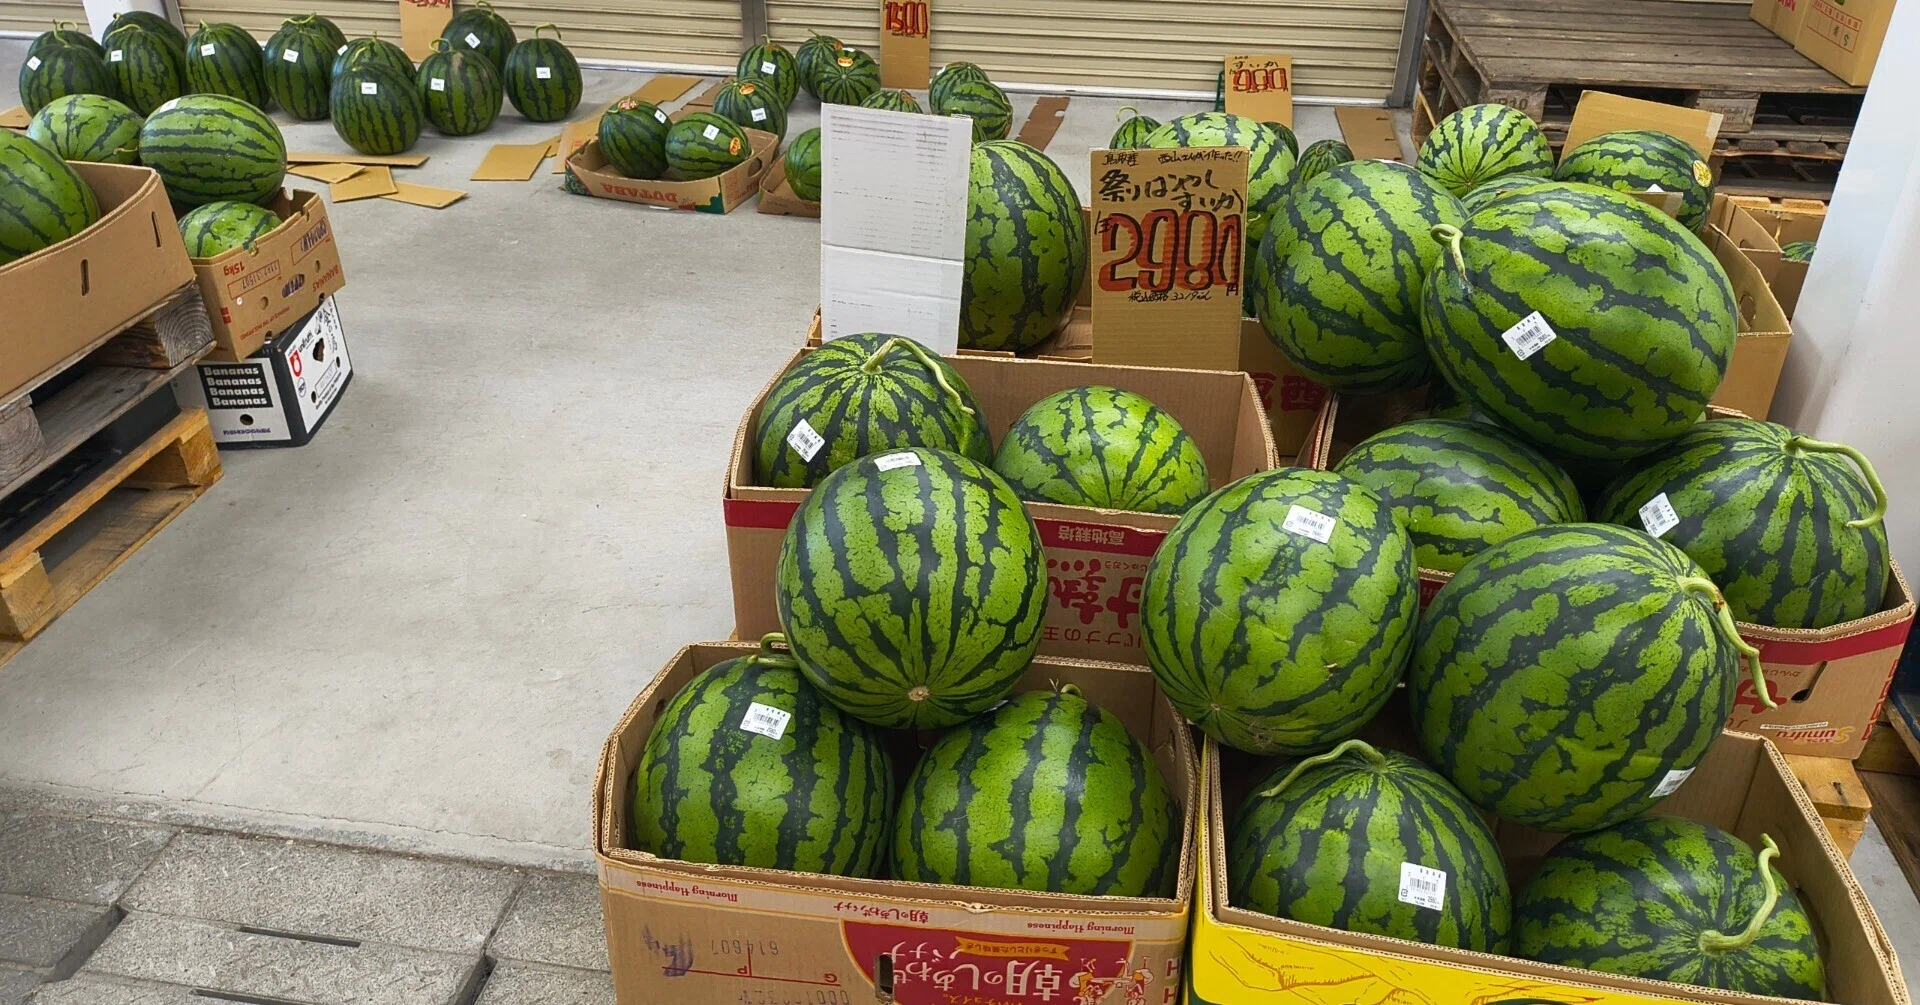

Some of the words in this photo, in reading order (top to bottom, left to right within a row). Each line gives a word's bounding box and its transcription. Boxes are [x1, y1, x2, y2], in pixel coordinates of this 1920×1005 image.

[1171, 189, 1244, 213] すいか
[1097, 208, 1242, 292] 2980
[222, 261, 245, 276] 15kg
[312, 264, 339, 293] BANANAS
[203, 366, 259, 376] Bananas
[206, 377, 262, 386] Bananas
[209, 387, 265, 396] Bananas
[212, 397, 268, 406] Bananas
[1057, 525, 1125, 546] 高地栽培
[1776, 726, 1855, 744] Sumifru
[636, 880, 689, 896] Happiness
[691, 886, 738, 902] Morning
[833, 901, 930, 924] 朝のしあわせバナナ
[1027, 919, 1084, 934] Happiness
[1086, 921, 1135, 936] Morning
[737, 965, 748, 974] P
[824, 973, 838, 983] G
[892, 959, 1062, 997] 朝のしあわせ
